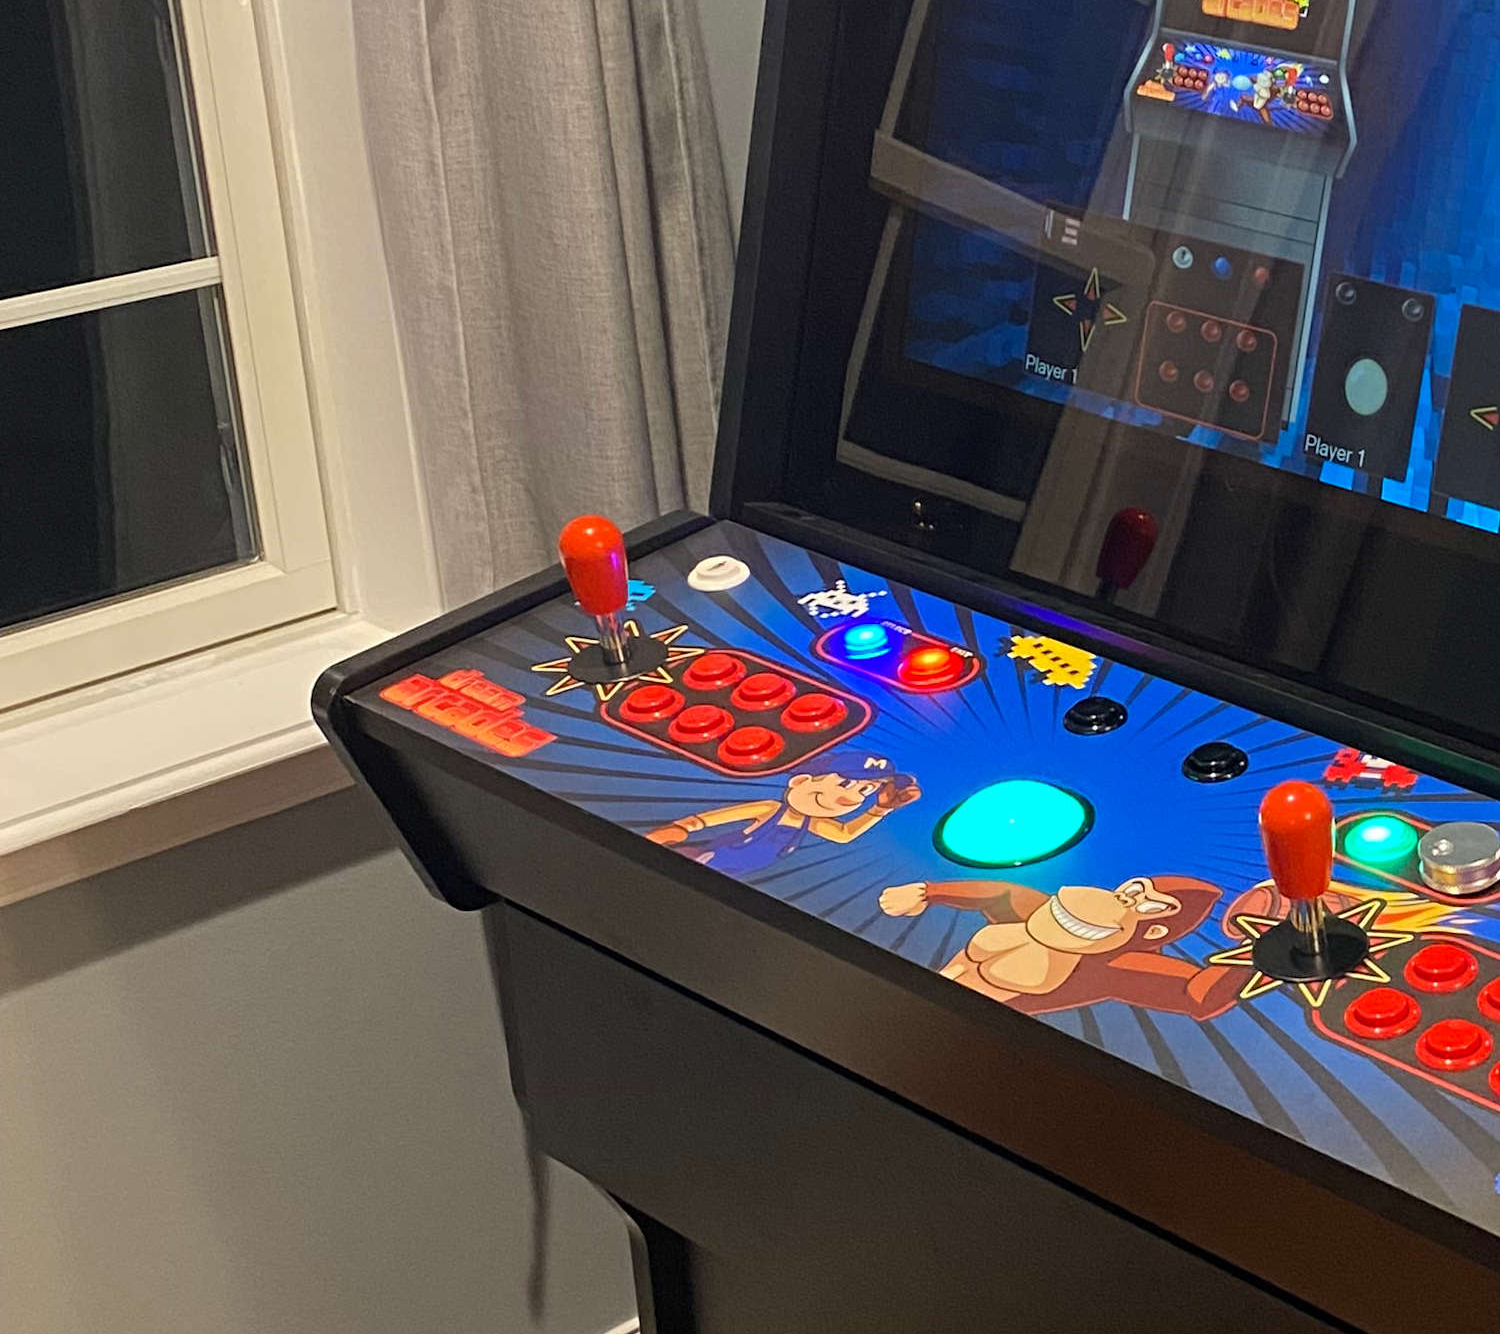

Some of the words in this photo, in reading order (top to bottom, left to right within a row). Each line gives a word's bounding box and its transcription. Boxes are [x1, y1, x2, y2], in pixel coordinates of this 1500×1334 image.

[1025, 353, 1067, 381] Player
[1071, 368, 1079, 385] 1
[1304, 433, 1354, 463] Player
[1357, 449, 1365, 468] 1
[438, 669, 527, 712] dream
[380, 675, 556, 756] arcades
